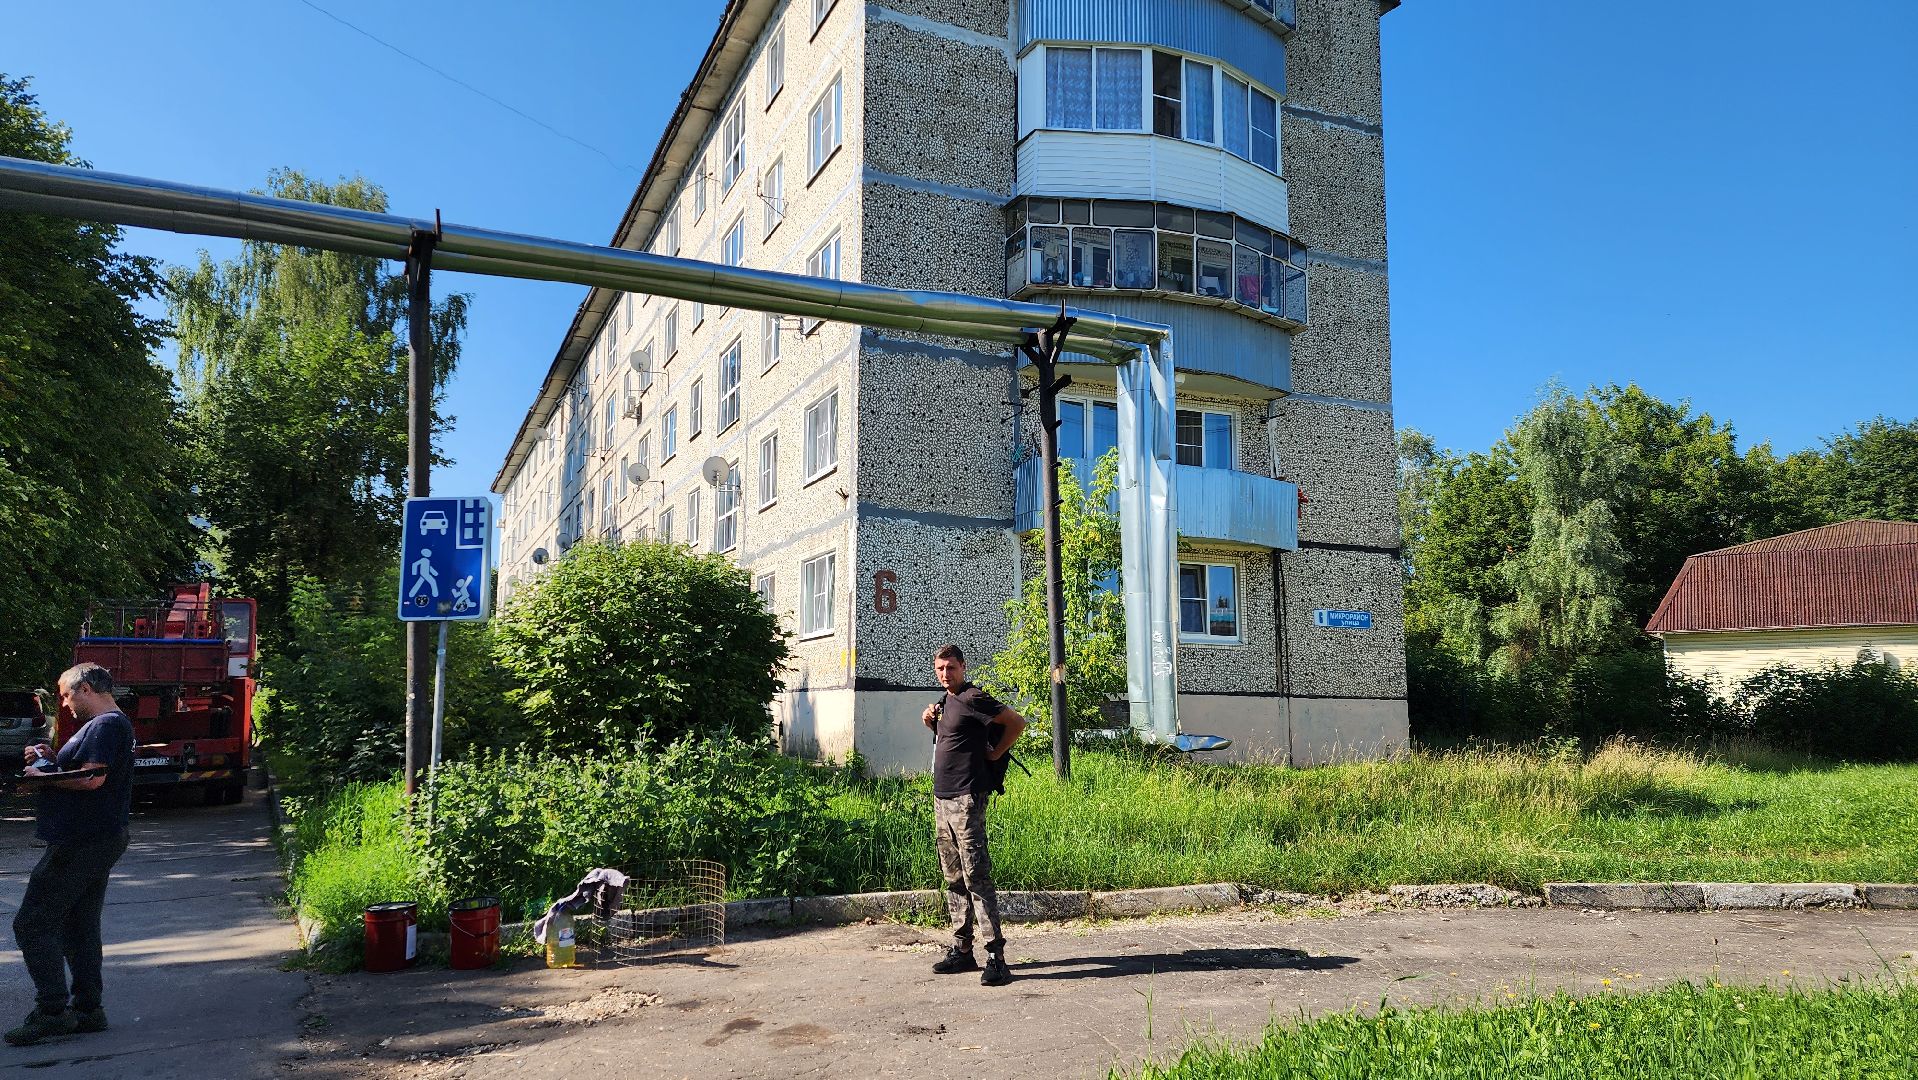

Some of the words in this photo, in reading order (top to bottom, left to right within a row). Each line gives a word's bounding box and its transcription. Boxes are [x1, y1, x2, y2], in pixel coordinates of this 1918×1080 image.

[875, 570, 898, 614] 6
[1318, 612, 1323, 623] 6
[1330, 612, 1368, 620] МИКРОРАЙОН
